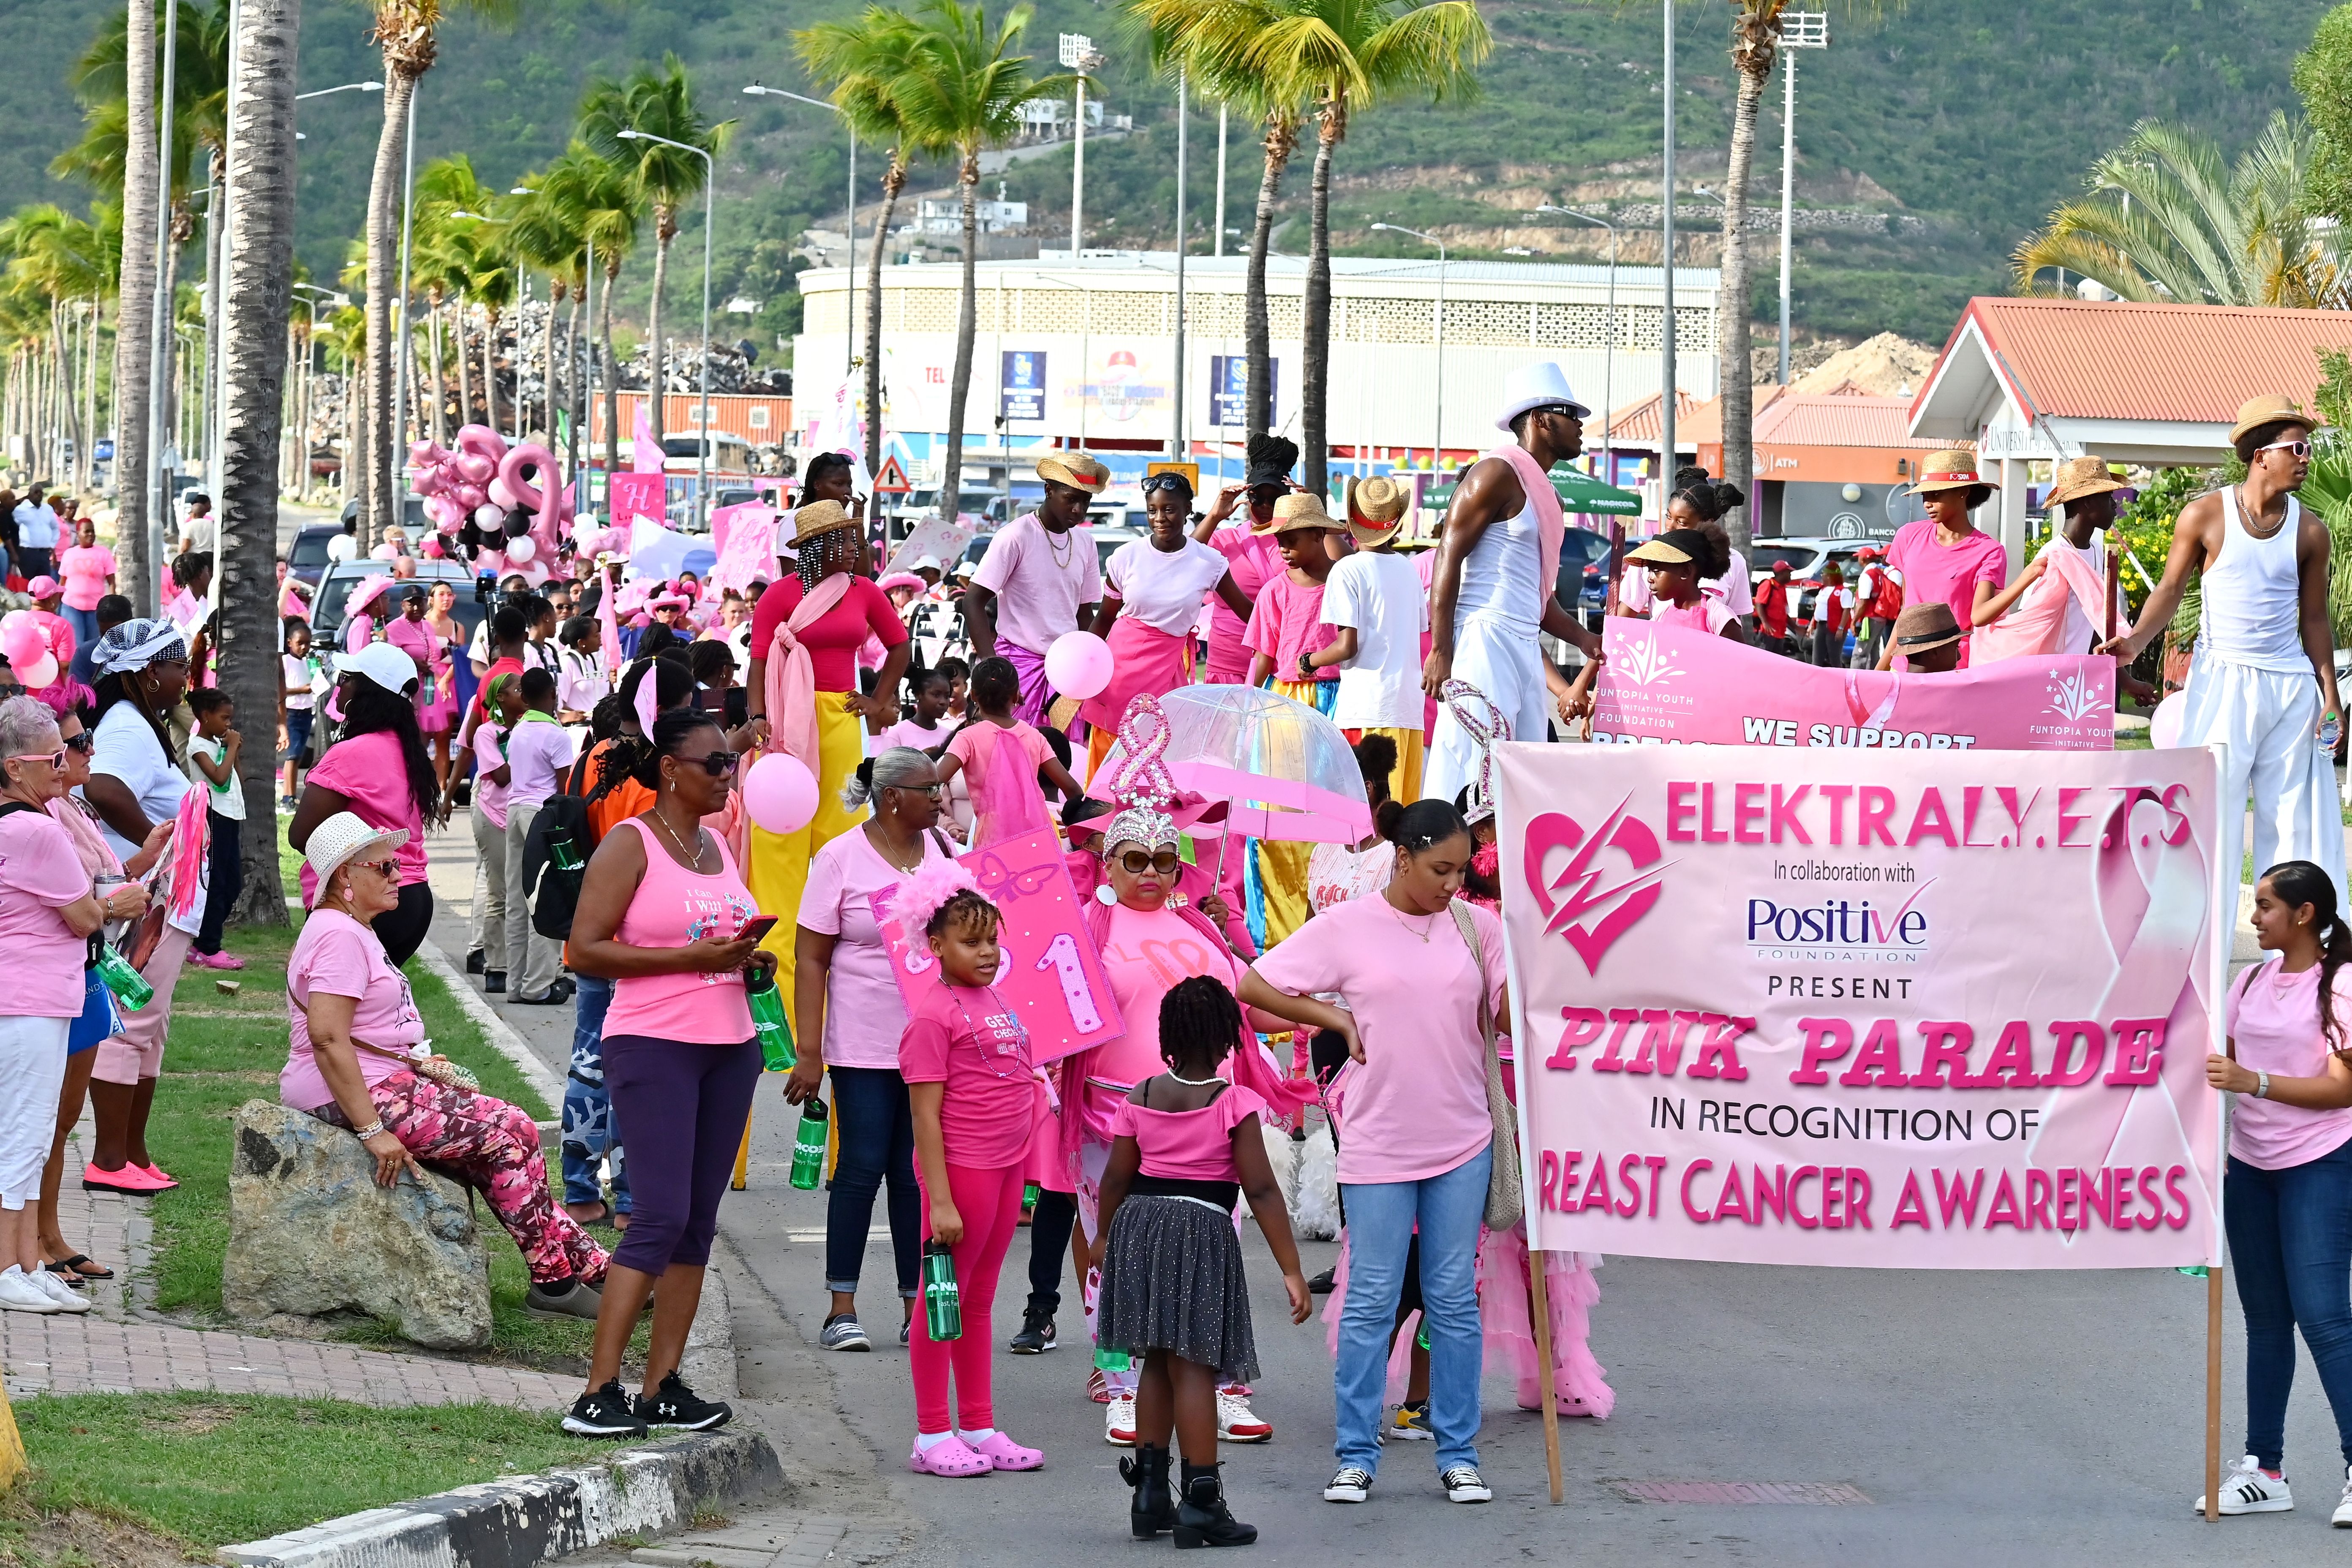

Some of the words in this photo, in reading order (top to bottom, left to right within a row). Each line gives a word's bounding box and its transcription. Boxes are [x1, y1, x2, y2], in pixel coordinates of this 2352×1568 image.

[1775, 458, 1798, 468] ATM
[1656, 693, 1693, 705] YOUTH
[1621, 703, 1663, 714] INITIATIVE
[1599, 713, 1674, 729] FOUNDATION
[1742, 716, 1798, 746] WE
[2030, 725, 2081, 736] FUNTOPIA
[2055, 740, 2094, 748] INITIATIVE
[1774, 860, 1786, 879] In
[1791, 859, 1880, 882] collaboration
[1884, 862, 1915, 882] with
[694, 889, 713, 898] Can
[683, 901, 692, 912] I
[695, 900, 723, 912] Will
[1748, 877, 1938, 945] Positive
[1758, 949, 1916, 962] FOUNDATION
[1768, 975, 1912, 999] PRESENT
[984, 1014, 1011, 1028] GET
[1544, 1005, 1756, 1081] PINK
[1788, 1015, 2169, 1089] PARADE
[1650, 1097, 1685, 1130] IN
[1699, 1099, 1973, 1142] RECOGNITION
[1986, 1108, 2040, 1141] OF
[1538, 1149, 1666, 1218] REAST
[1680, 1158, 1872, 1231] CANCER
[1890, 1165, 2190, 1231] AWARENESS
